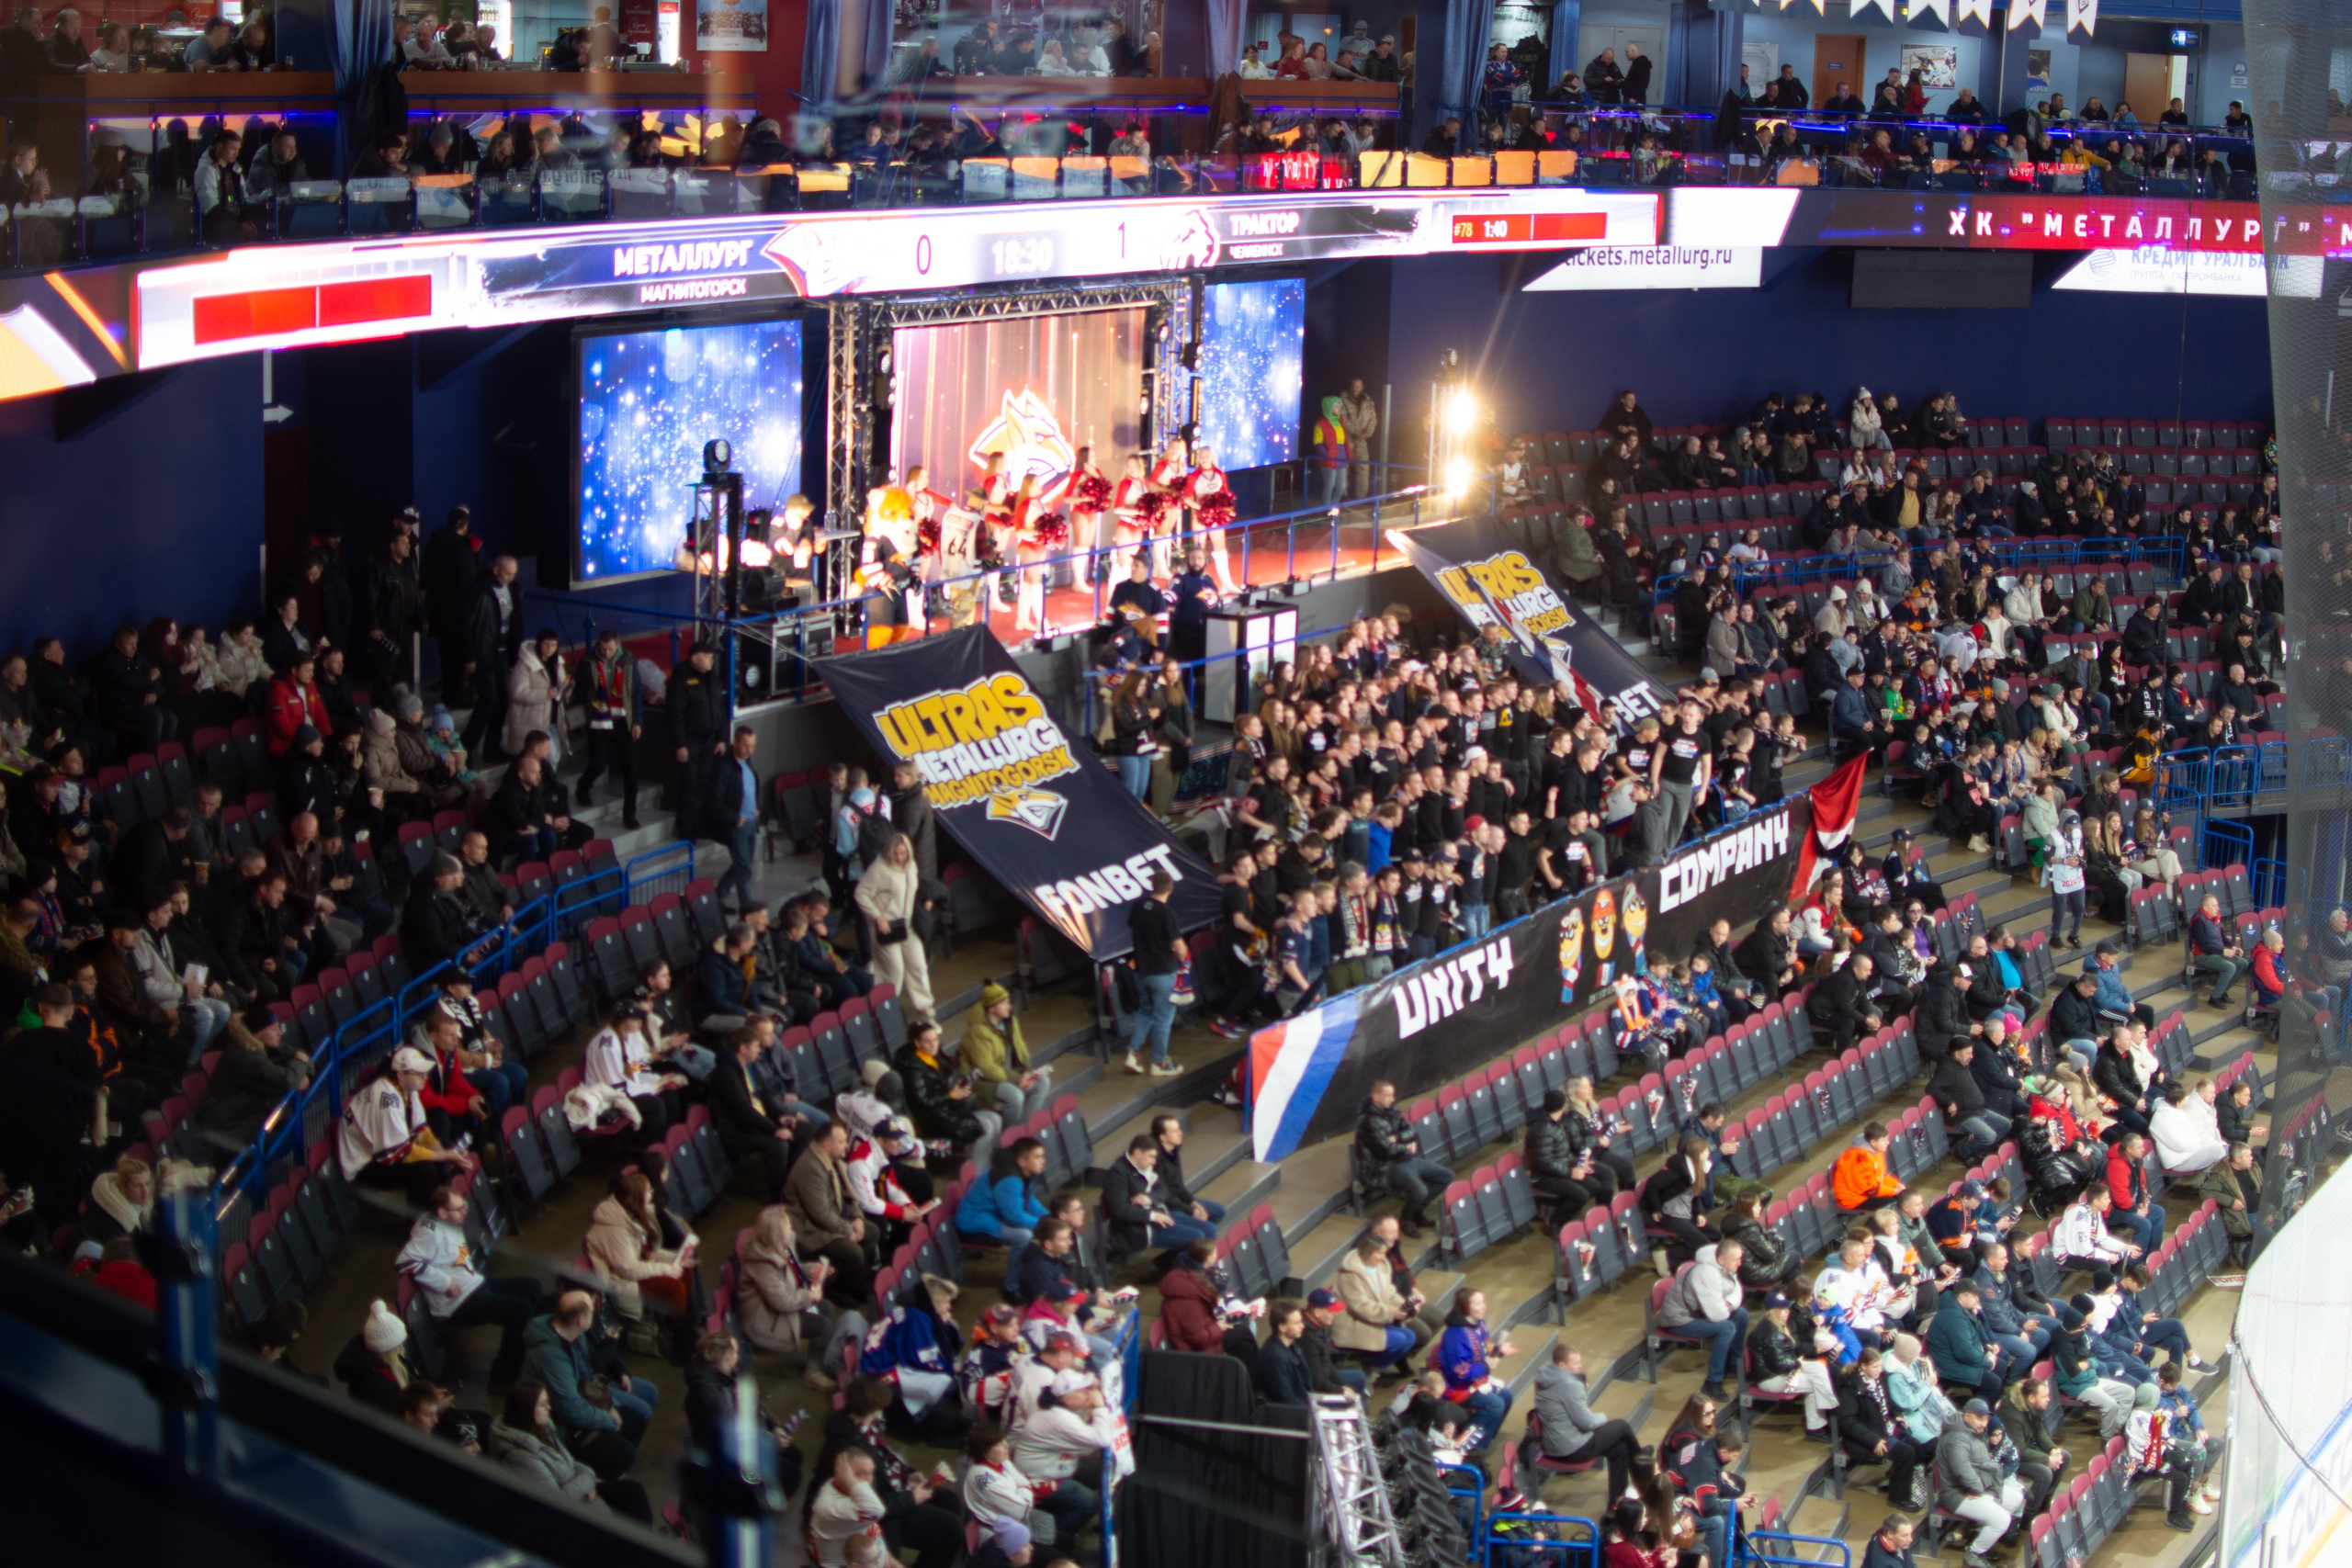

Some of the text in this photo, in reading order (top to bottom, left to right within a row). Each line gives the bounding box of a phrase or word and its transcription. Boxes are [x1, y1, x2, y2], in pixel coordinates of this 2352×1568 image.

[1117, 220, 1126, 259] 1
[1229, 211, 1300, 237] ТРАКТОР
[1453, 220, 1508, 238] #78 1:40
[1949, 210, 1993, 236] ХК
[613, 239, 753, 276] МЕТАЛЛУРГ
[916, 233, 932, 276] 0
[991, 236, 1054, 275] 18:30
[2131, 250, 2195, 269] КРЕДИТ
[2204, 252, 2245, 267] УРАЛ
[640, 278, 747, 304] МАГНИТОГОРСК
[874, 672, 1046, 760] ULTRAS
[922, 744, 1077, 806] MAGNITOGORSK
[1034, 842, 1183, 919] FONBET
[1659, 809, 1789, 914] COMPANY
[1391, 935, 1514, 1040] UNITY
